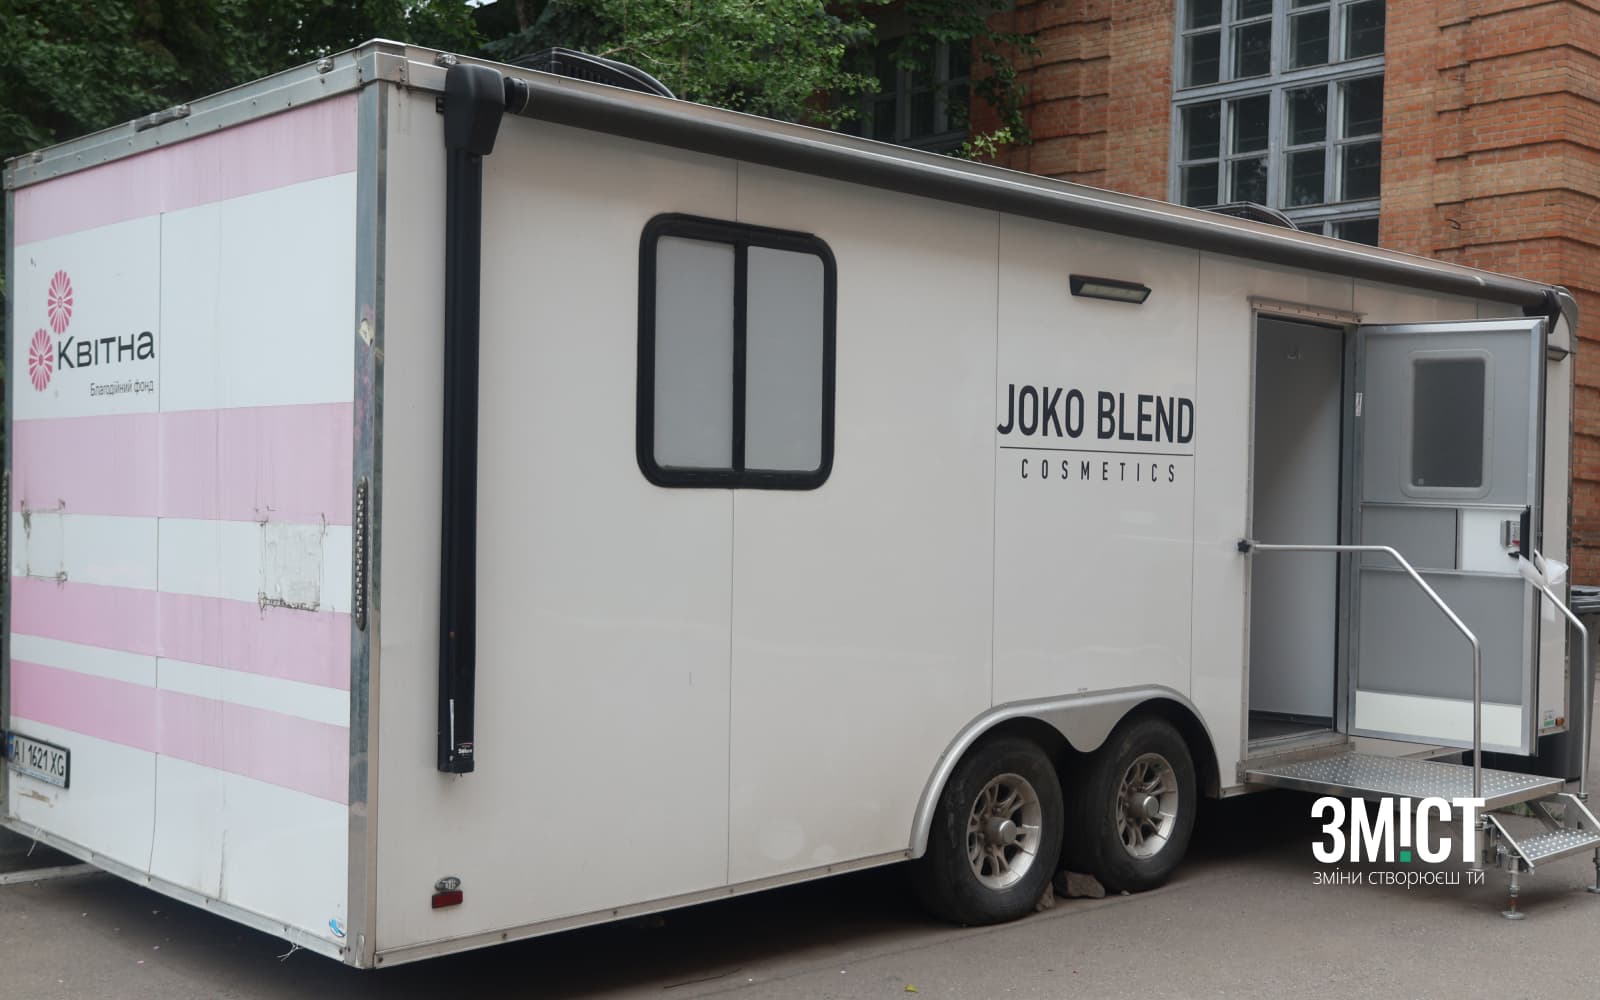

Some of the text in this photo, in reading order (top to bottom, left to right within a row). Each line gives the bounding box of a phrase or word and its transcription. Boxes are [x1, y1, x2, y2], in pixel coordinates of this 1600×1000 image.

[90, 378, 154, 397] Благодійний фонд
[996, 383, 1194, 444] JOKO BLEND
[1021, 458, 1175, 483] COSMETICS
[14, 739, 25, 763] AI
[28, 744, 48, 771] 1621
[50, 751, 65, 777] XG
